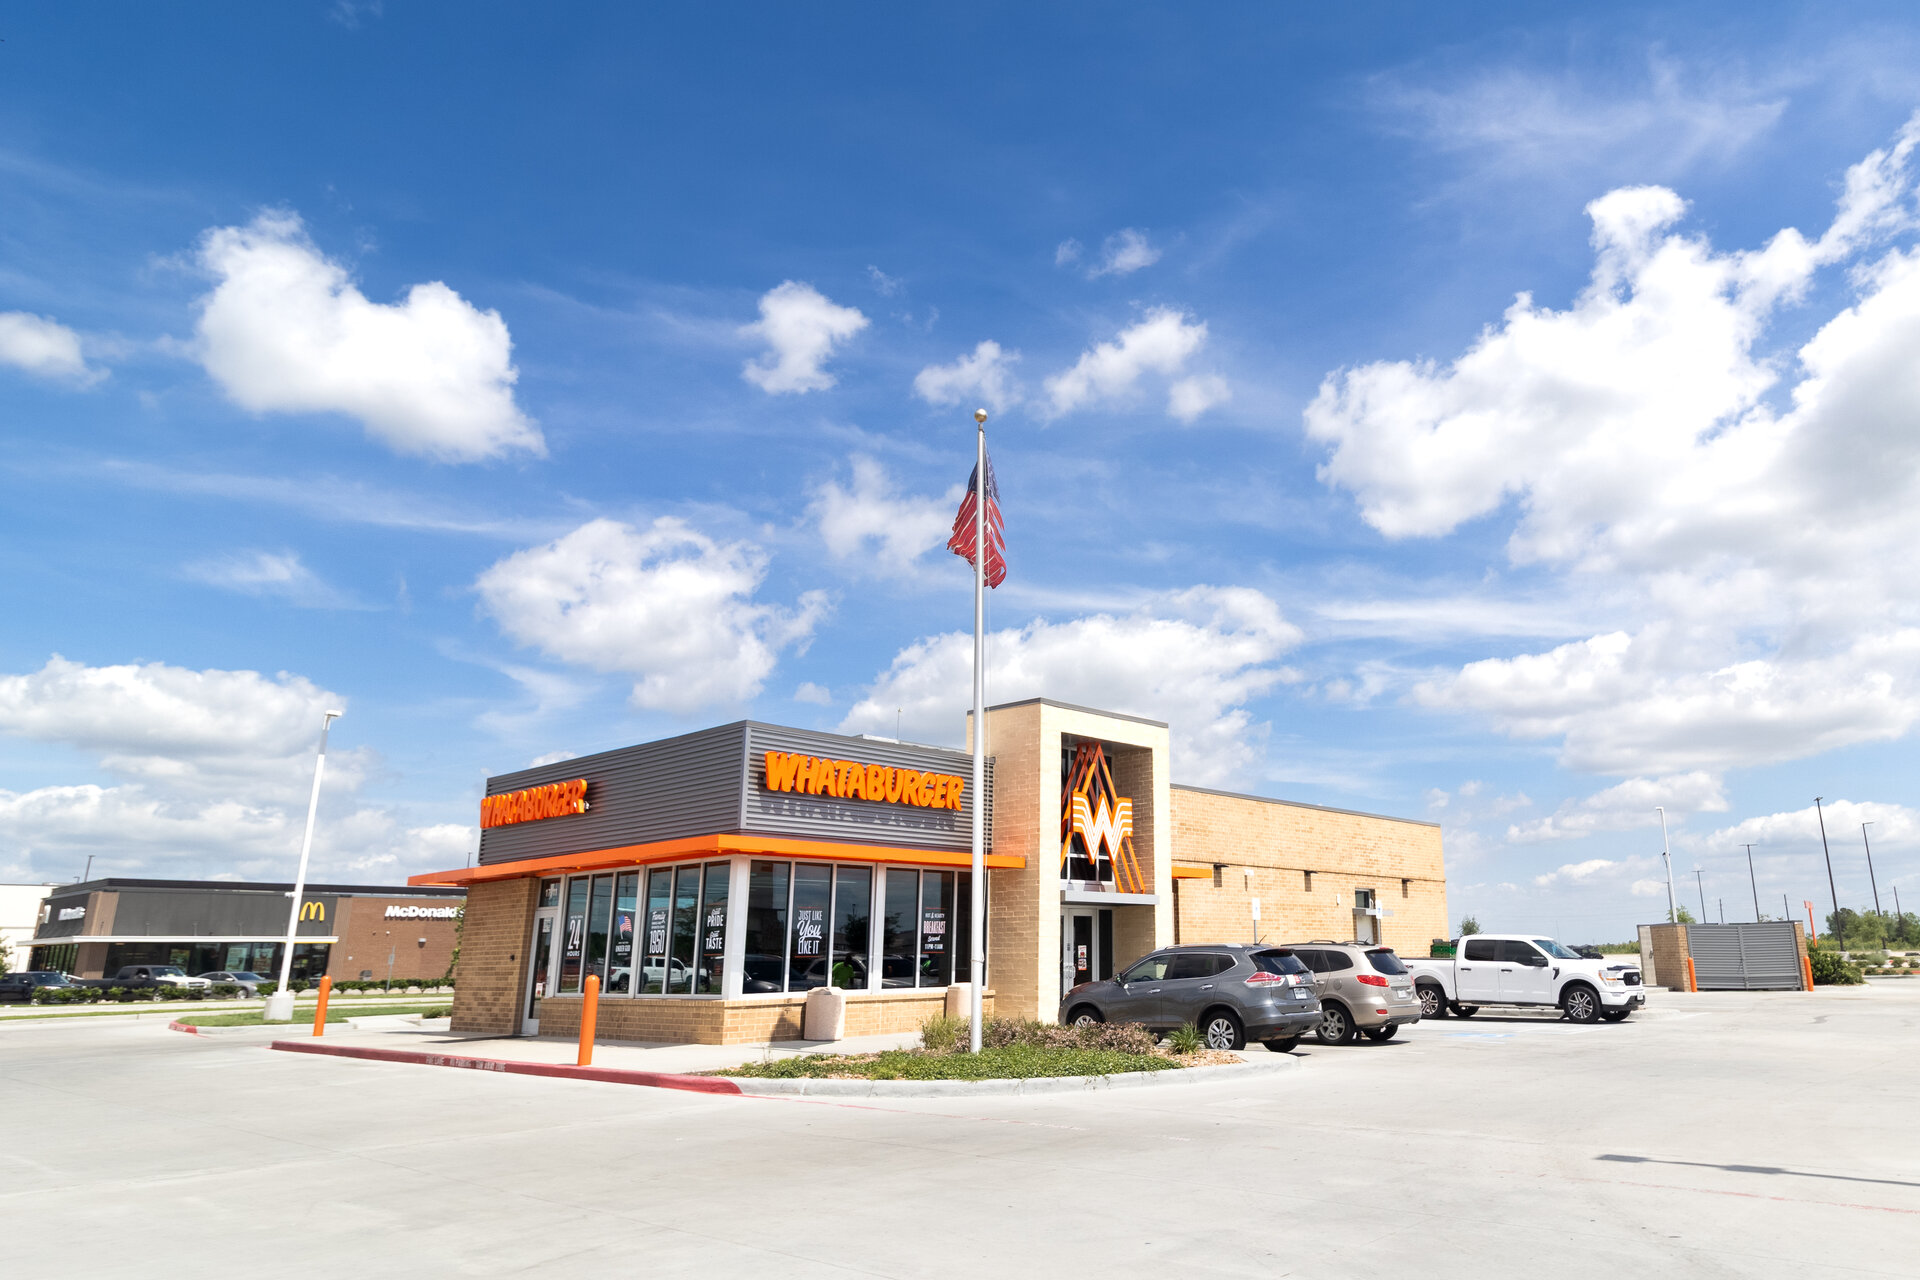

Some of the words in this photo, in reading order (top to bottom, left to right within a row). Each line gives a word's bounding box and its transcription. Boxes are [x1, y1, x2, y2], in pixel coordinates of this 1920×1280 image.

[765, 751, 965, 812] WHATABURGER
[480, 779, 588, 829] WHATABURGER
[385, 905, 465, 918] McDonalds
[798, 910, 811, 921] JUST
[812, 910, 823, 921] LIKE
[707, 915, 724, 927] PRIDE
[923, 920, 946, 934] BREAKFAST
[568, 919, 582, 950] 24
[796, 920, 822, 941] You
[649, 929, 666, 954] 1950
[706, 937, 723, 950] TASTE
[797, 940, 812, 955] LIKE
[812, 940, 820, 955] IT
